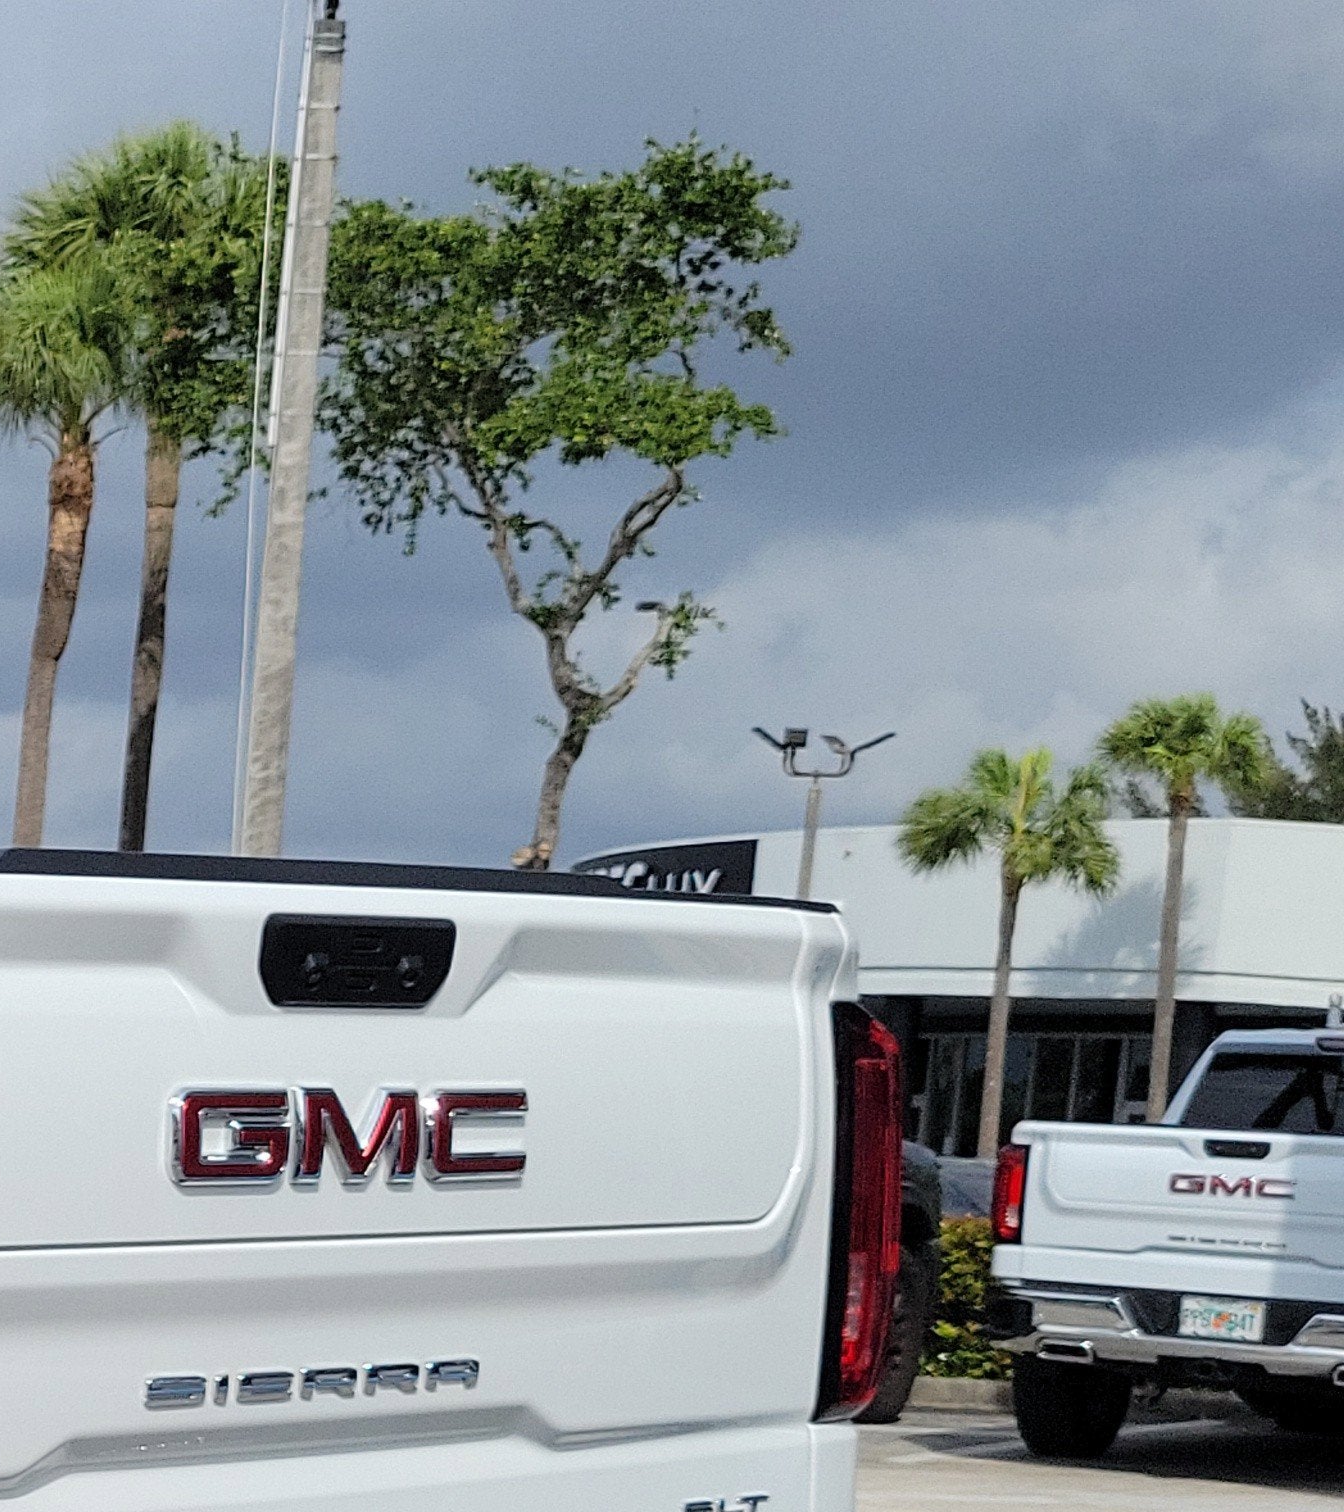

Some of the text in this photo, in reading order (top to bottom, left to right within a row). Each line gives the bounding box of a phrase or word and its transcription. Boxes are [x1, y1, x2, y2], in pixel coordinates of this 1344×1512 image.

[167, 1086, 529, 1189] GMC
[1169, 1173, 1296, 1200] GMC
[143, 1357, 480, 1411] SIERRA
